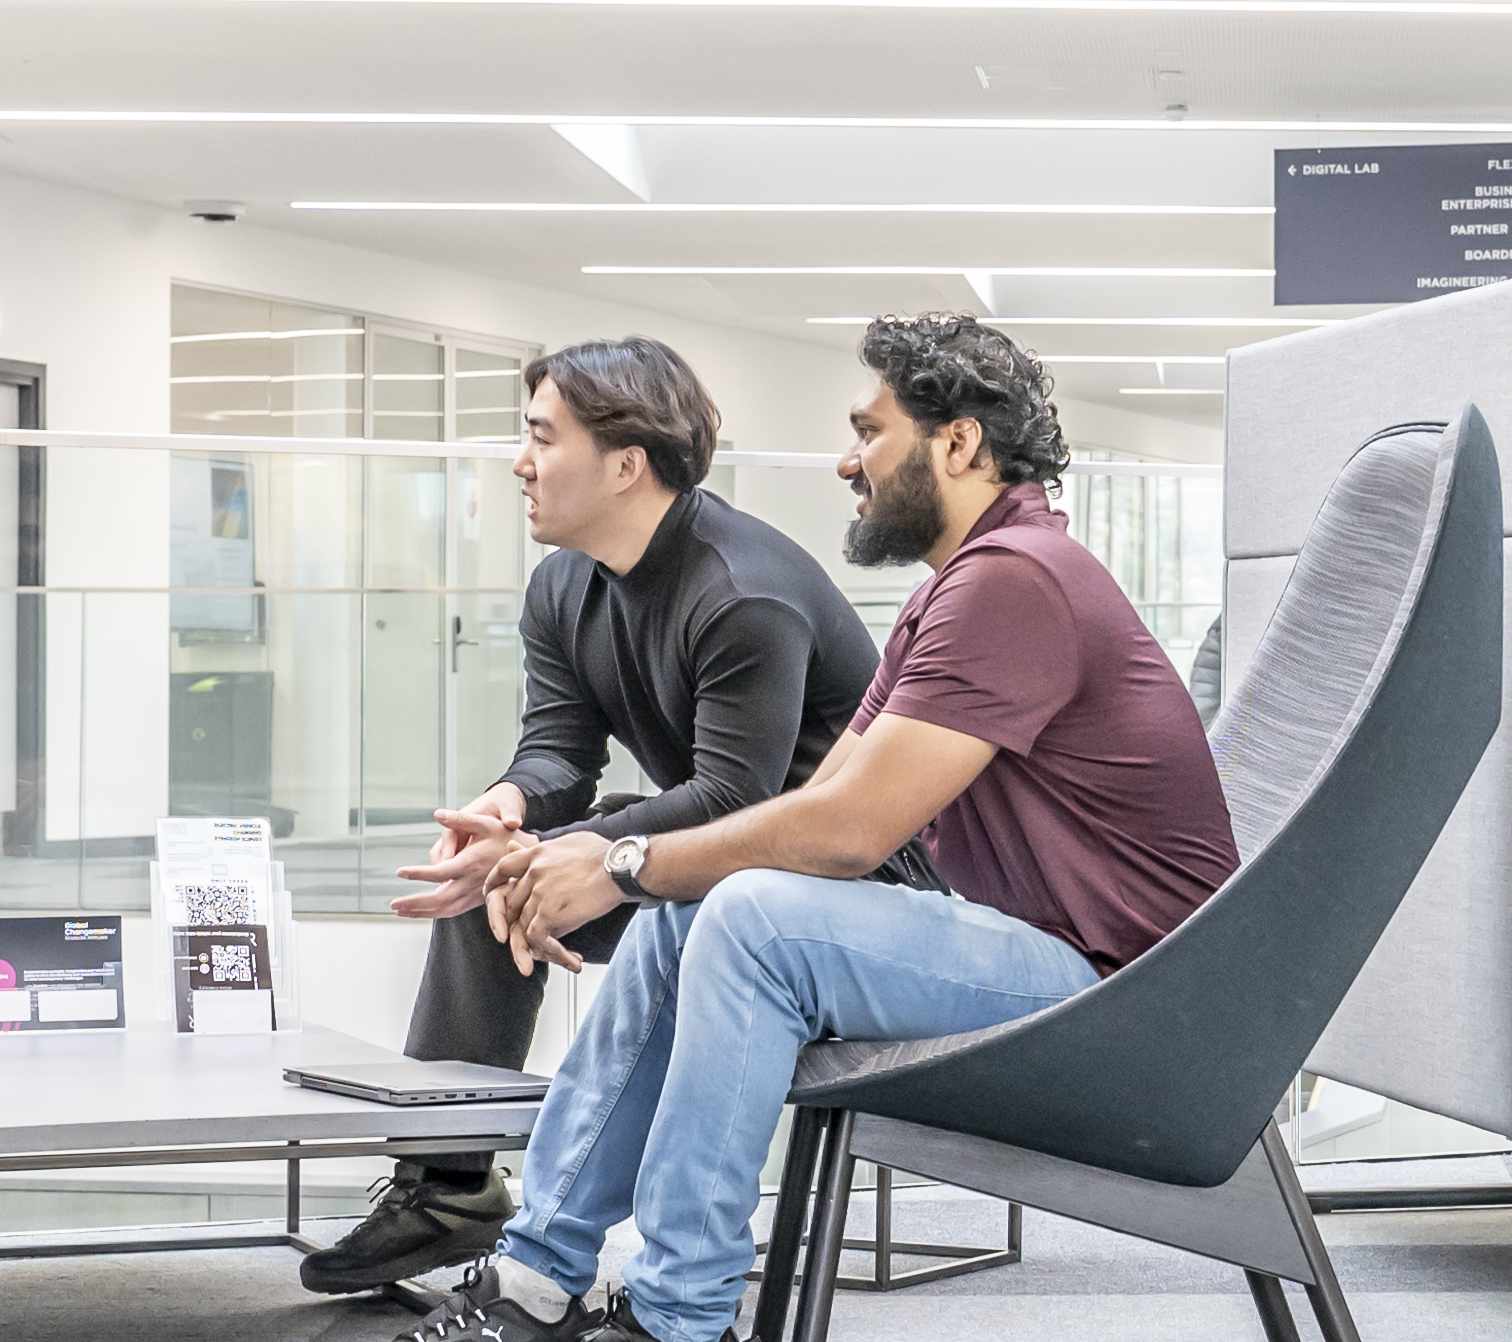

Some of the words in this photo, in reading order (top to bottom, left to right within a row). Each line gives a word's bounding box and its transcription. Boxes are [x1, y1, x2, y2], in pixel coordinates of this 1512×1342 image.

[1302, 164, 1351, 175] DIGITAL
[1354, 162, 1380, 174] LAB
[1450, 224, 1508, 235] PARTNER
